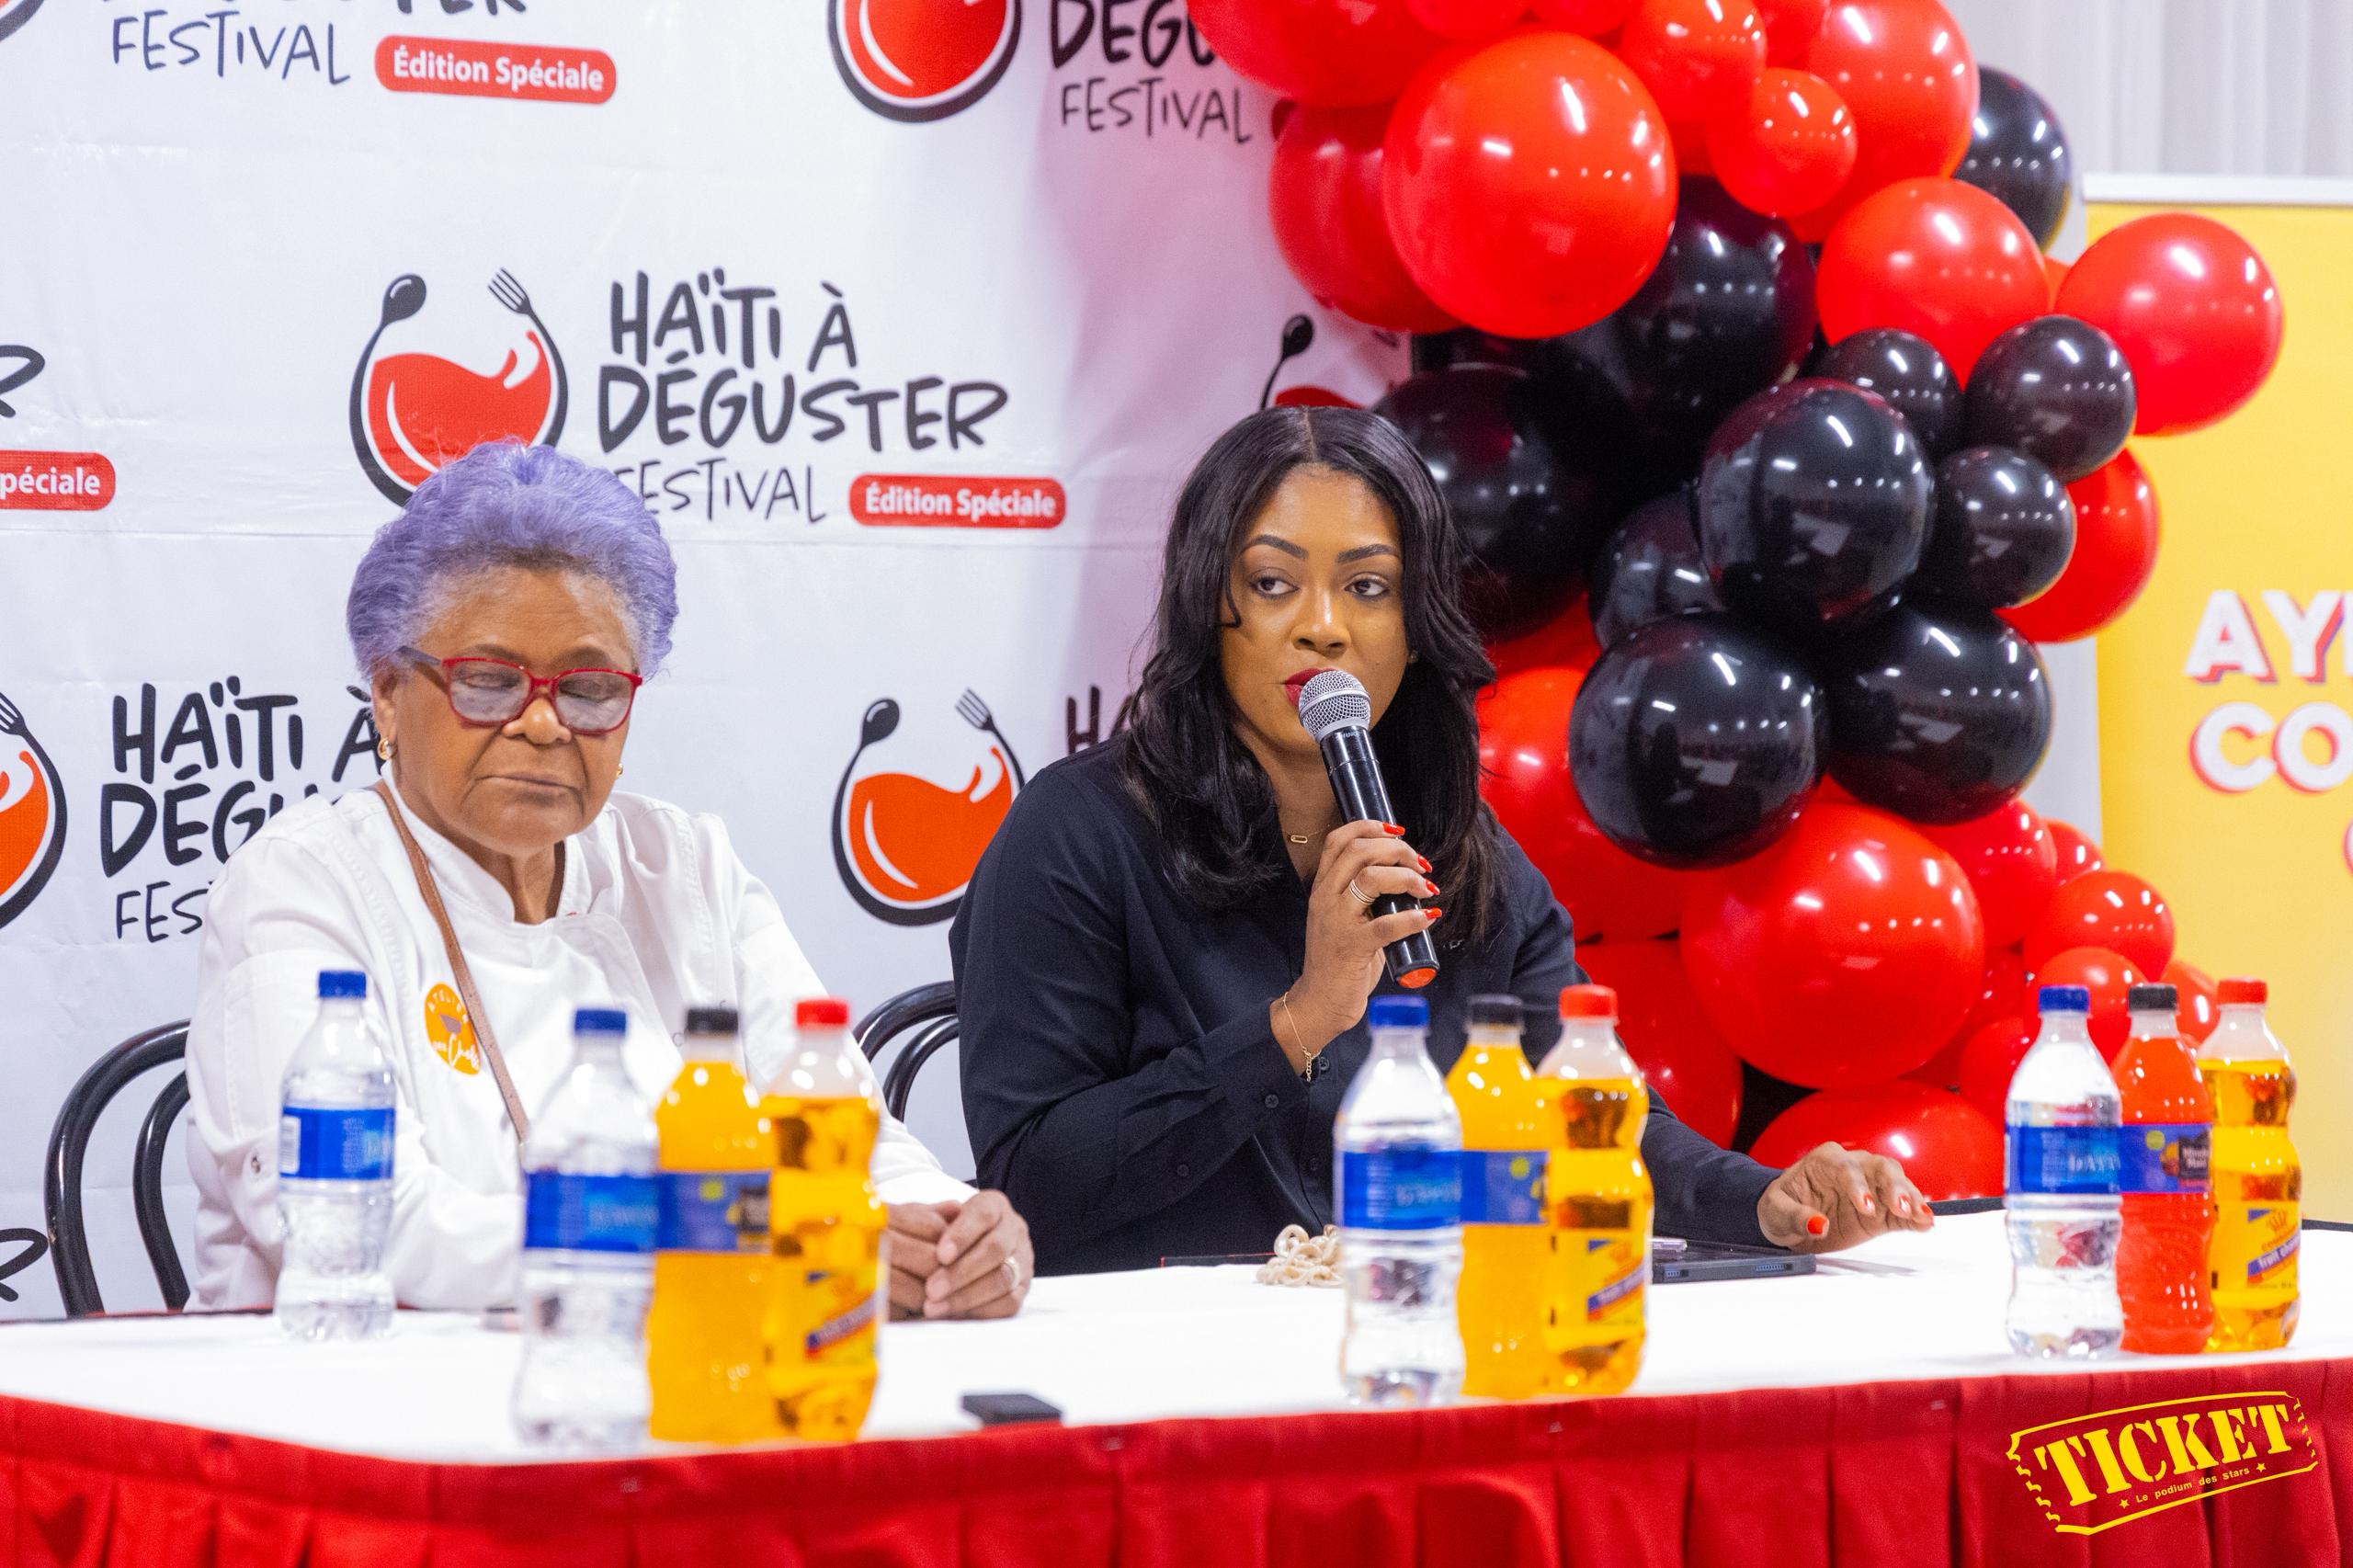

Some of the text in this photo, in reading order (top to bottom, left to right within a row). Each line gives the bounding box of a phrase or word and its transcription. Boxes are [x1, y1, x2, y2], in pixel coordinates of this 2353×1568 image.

[113, 9, 604, 93] FESTIVAL Édition Spéciale
[1063, 76, 1254, 144] FESTIVAL
[610, 267, 857, 372] HAÏTI À
[598, 349, 1008, 454] DÉGUSTER
[865, 482, 952, 516] Édition
[956, 487, 1057, 523] Spéciale
[2184, 590, 2353, 685] AY
[112, 676, 303, 784] HAÏTI
